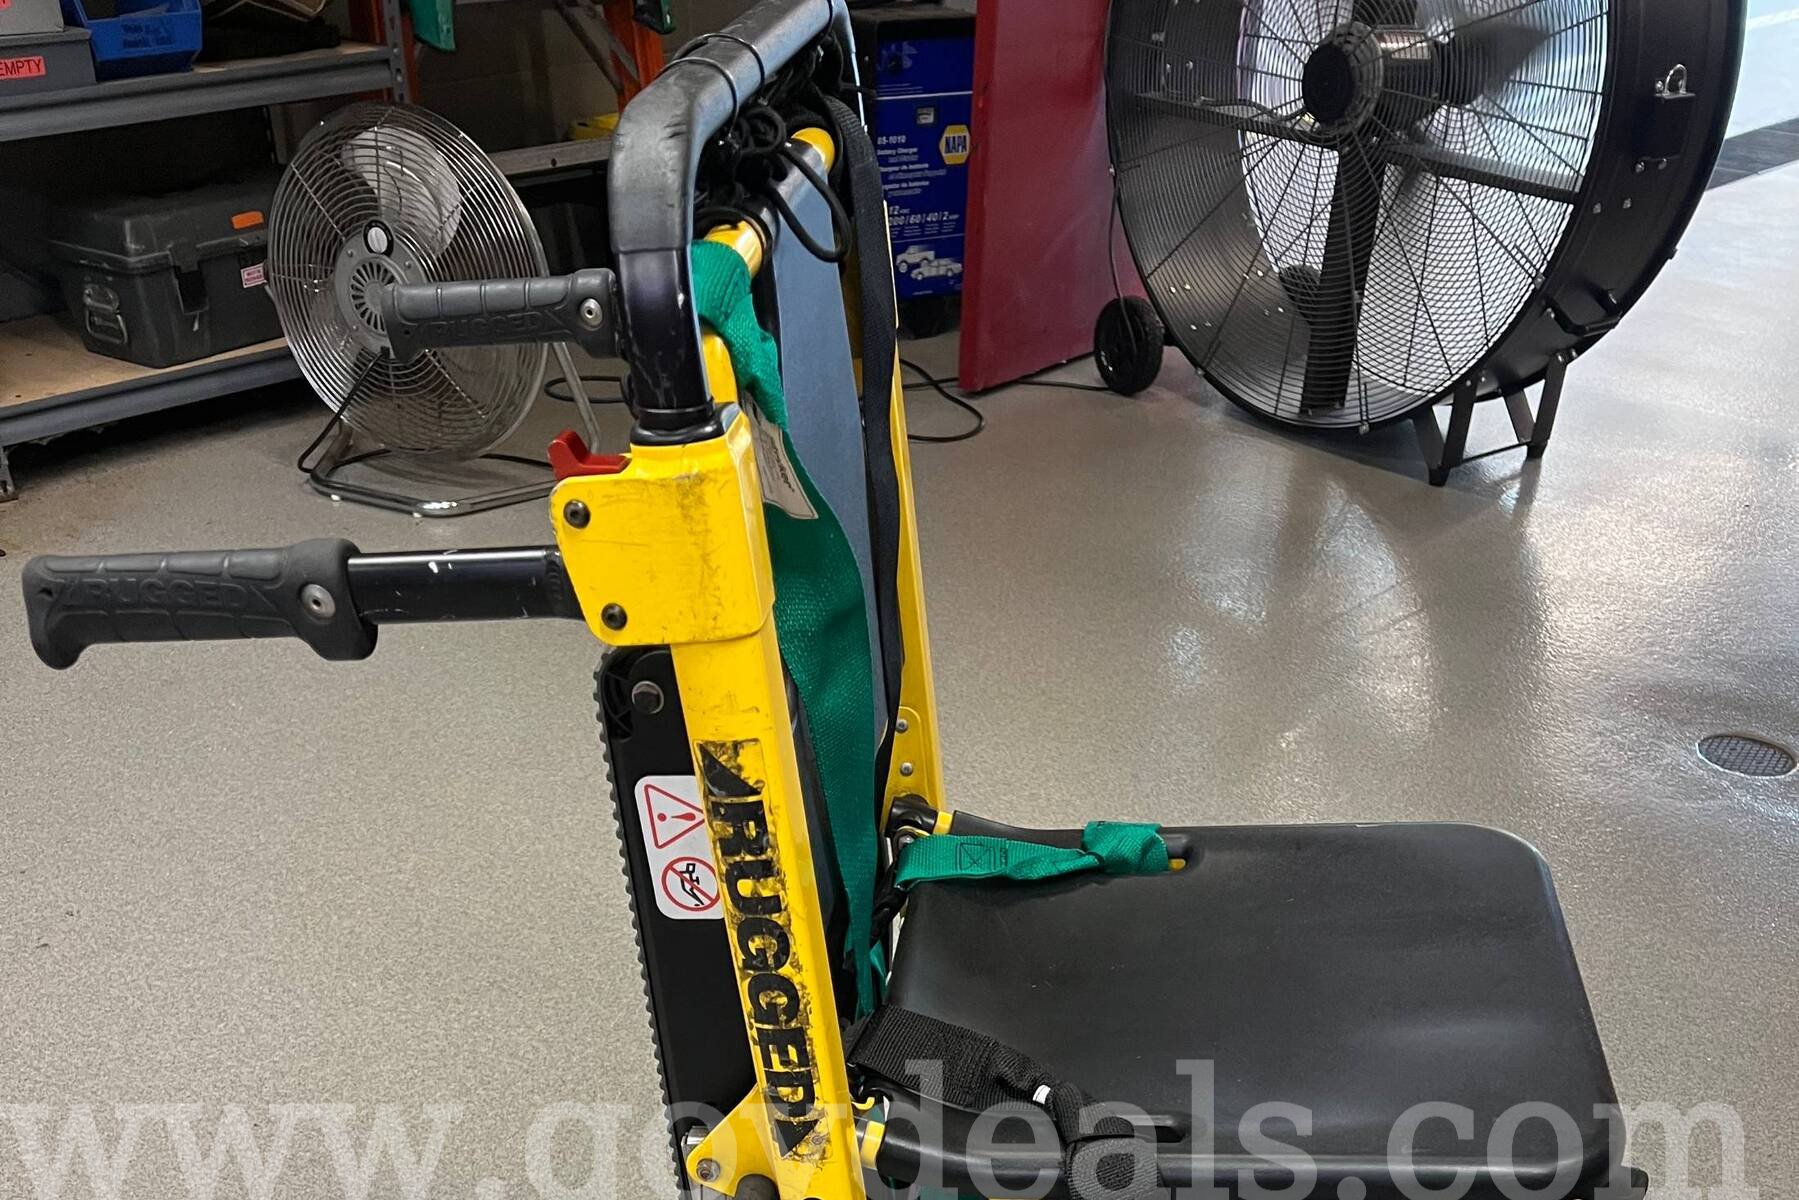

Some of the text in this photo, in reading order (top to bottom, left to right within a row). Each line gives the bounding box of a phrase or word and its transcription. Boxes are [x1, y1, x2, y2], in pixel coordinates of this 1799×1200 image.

[944, 135, 968, 154] NAPA
[76, 577, 248, 608] RUGGED
[710, 800, 817, 1121] RUGGED
